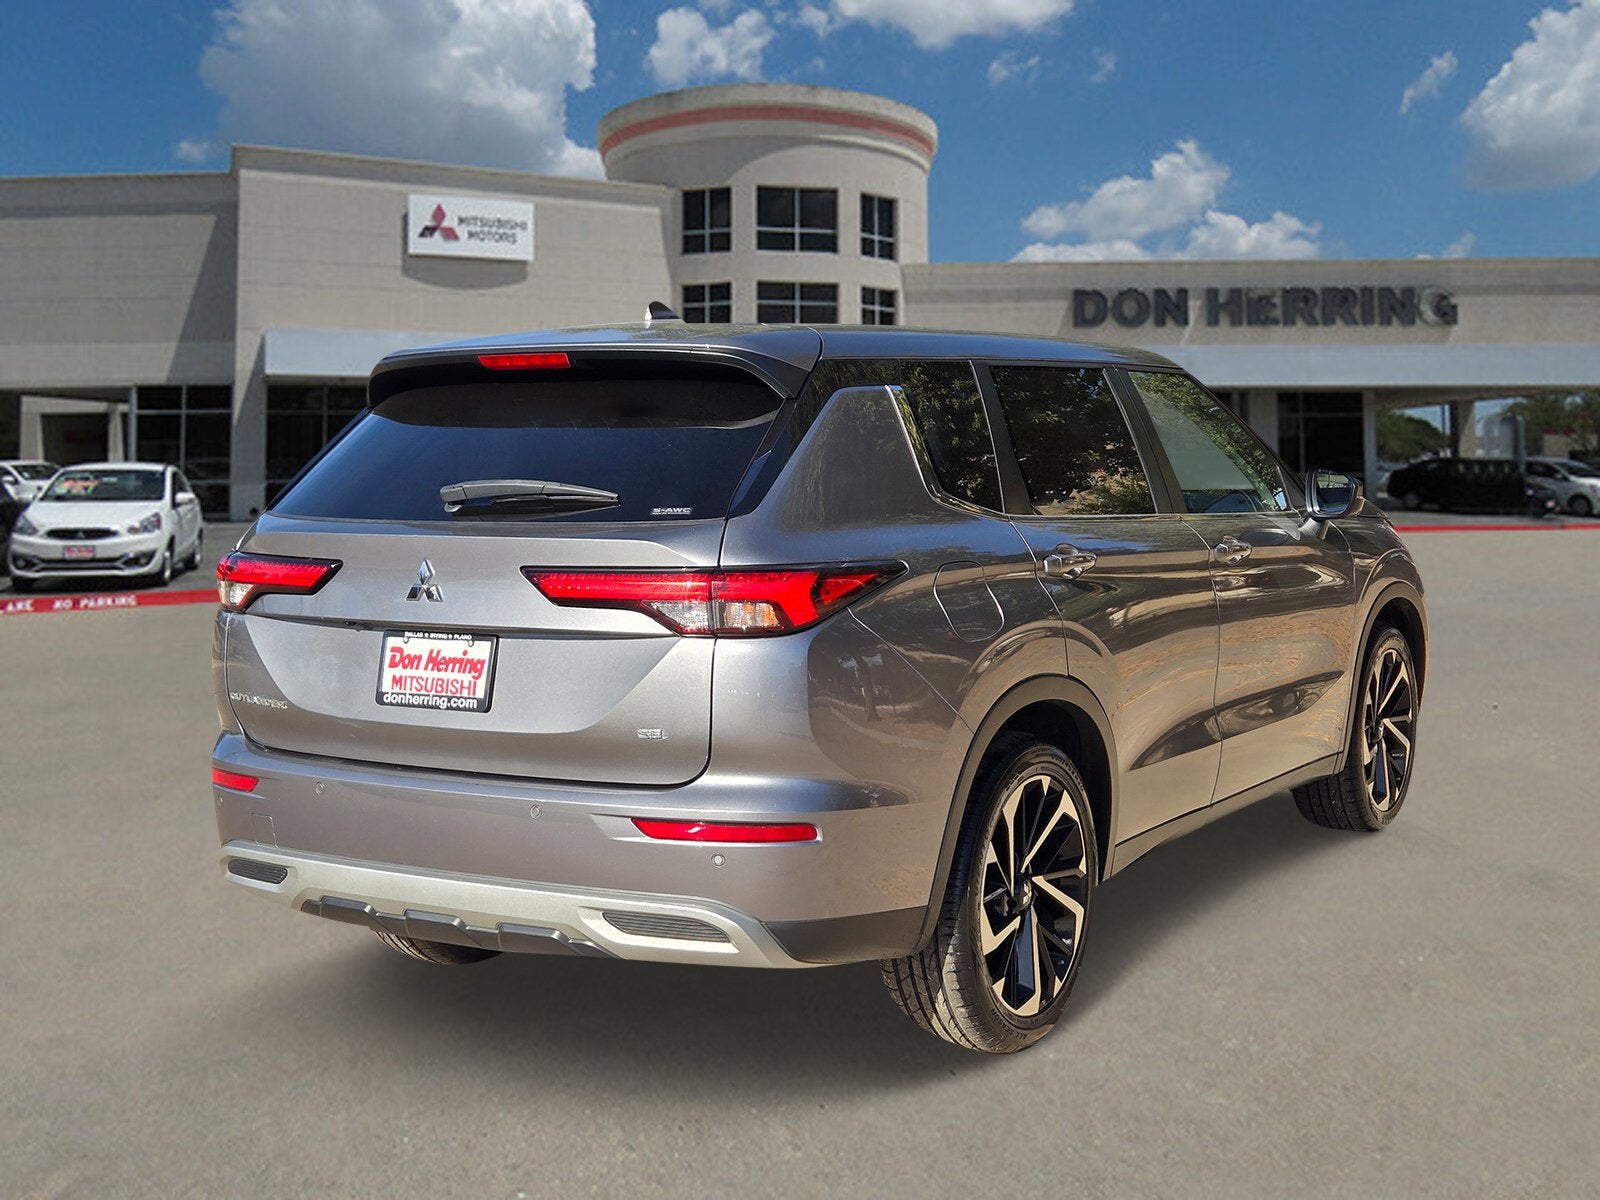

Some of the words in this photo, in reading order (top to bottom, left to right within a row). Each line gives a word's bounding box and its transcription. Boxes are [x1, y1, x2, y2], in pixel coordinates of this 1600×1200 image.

[1072, 287, 1189, 328] DON
[1205, 286, 1458, 328] HERRING
[53, 599, 73, 610] NO
[79, 594, 137, 608] PARKING
[388, 646, 422, 670] Don
[423, 648, 486, 680] Herring
[391, 674, 477, 697] MITSUBISHI
[383, 692, 478, 709] donherring.com
